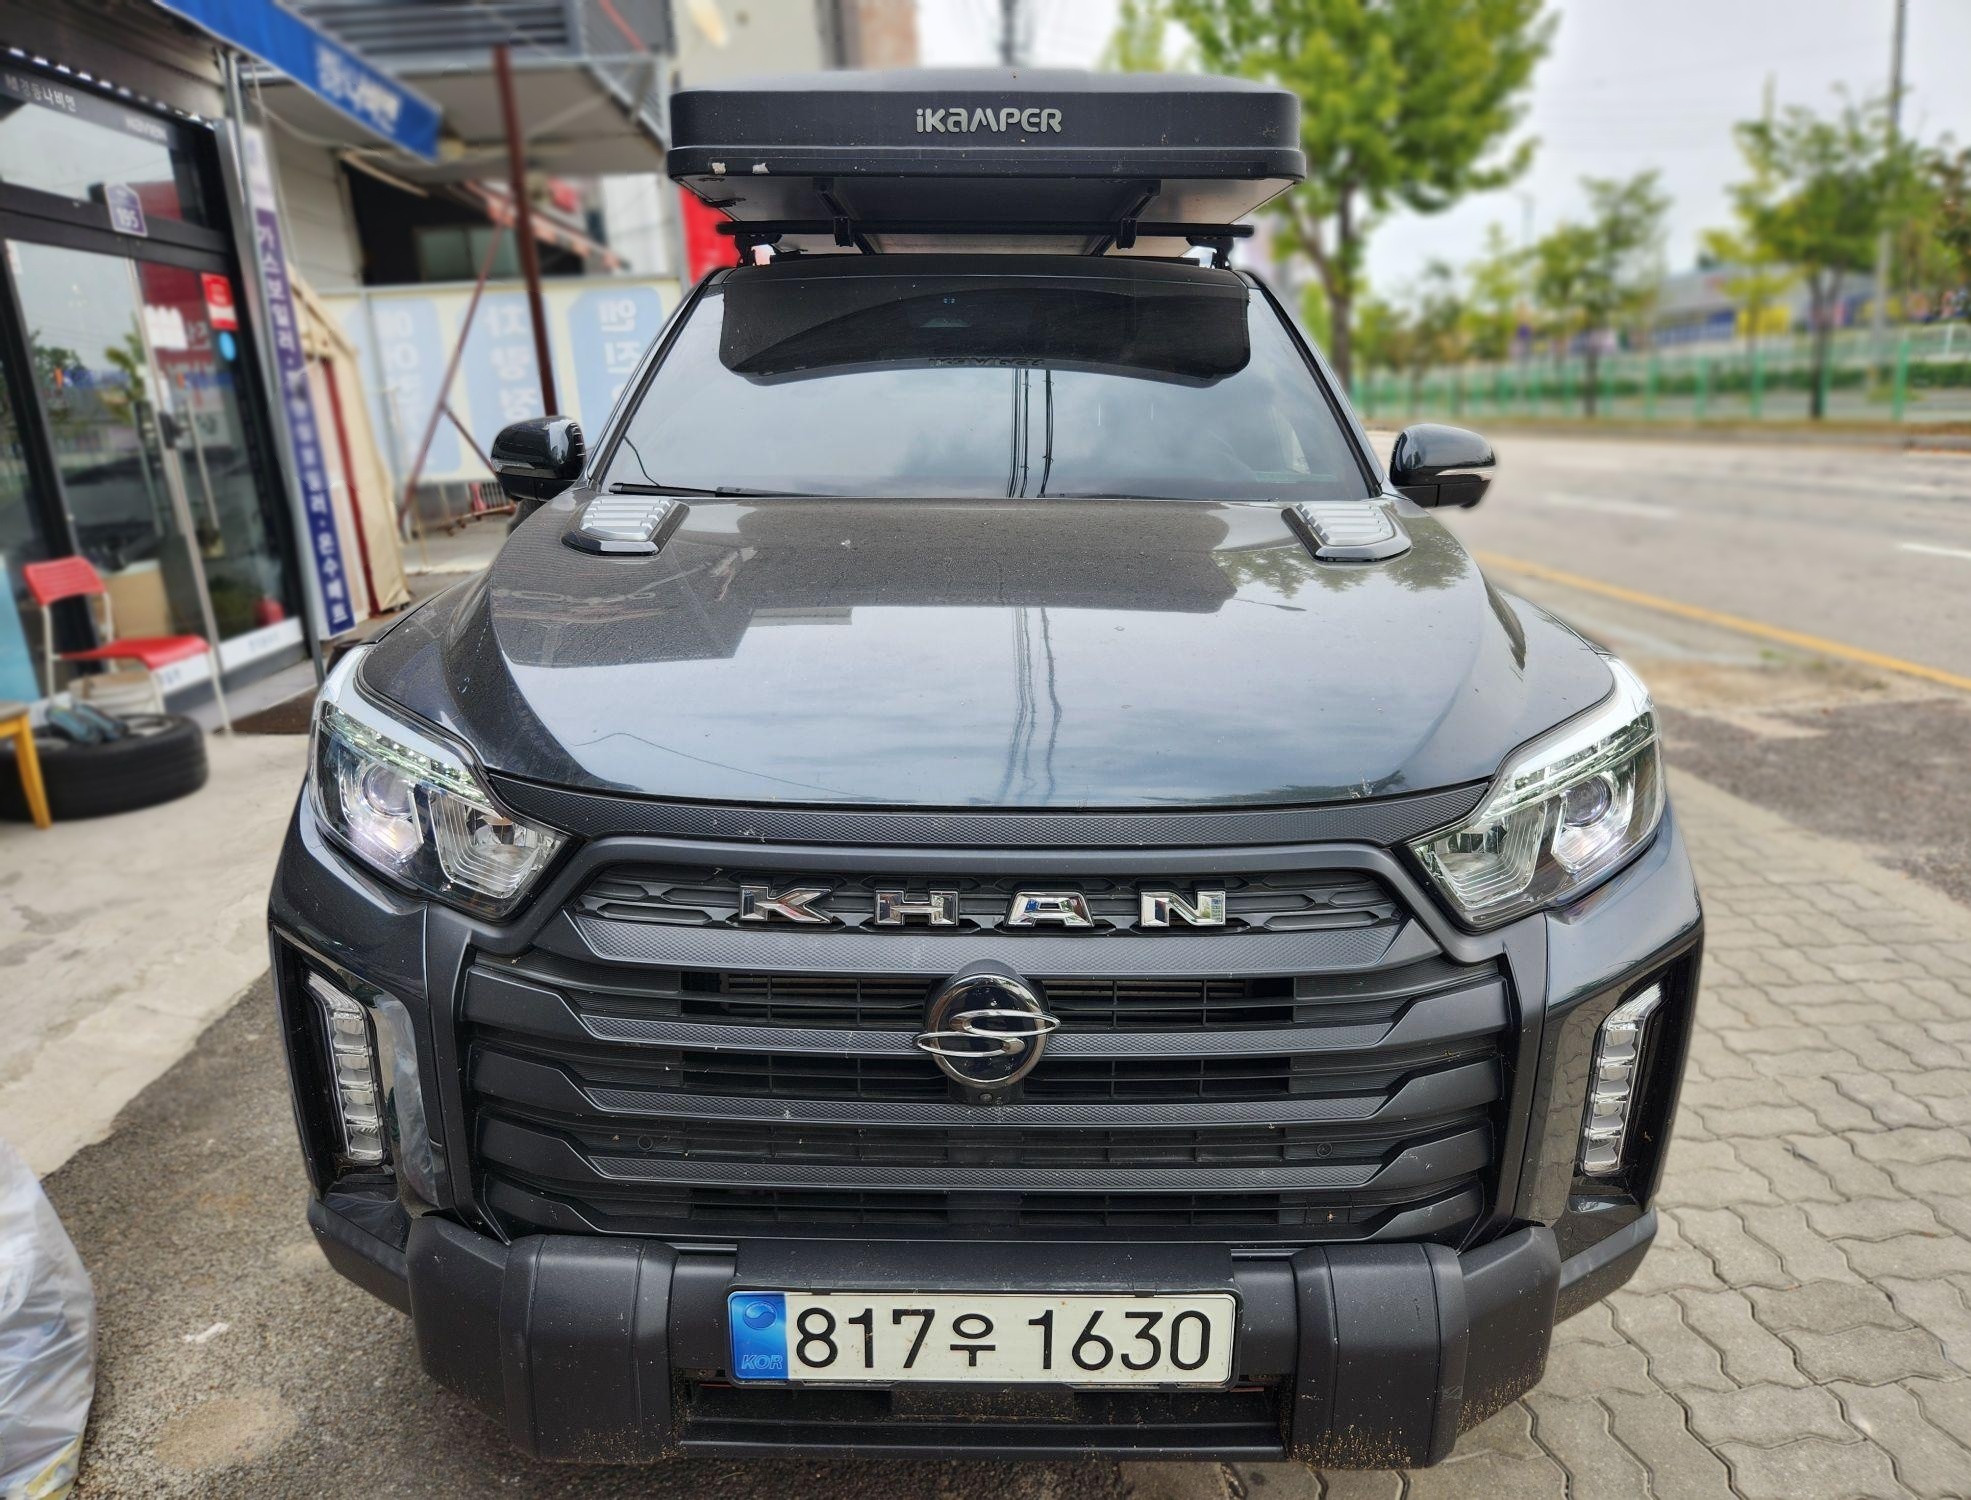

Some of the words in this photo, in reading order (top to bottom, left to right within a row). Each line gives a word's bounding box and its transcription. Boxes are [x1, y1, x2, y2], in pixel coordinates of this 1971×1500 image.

[738, 884, 1227, 928] KHAN
[796, 1306, 996, 1369] 817우
[1027, 1309, 1212, 1371] 1630
[741, 1354, 783, 1369] KOR
